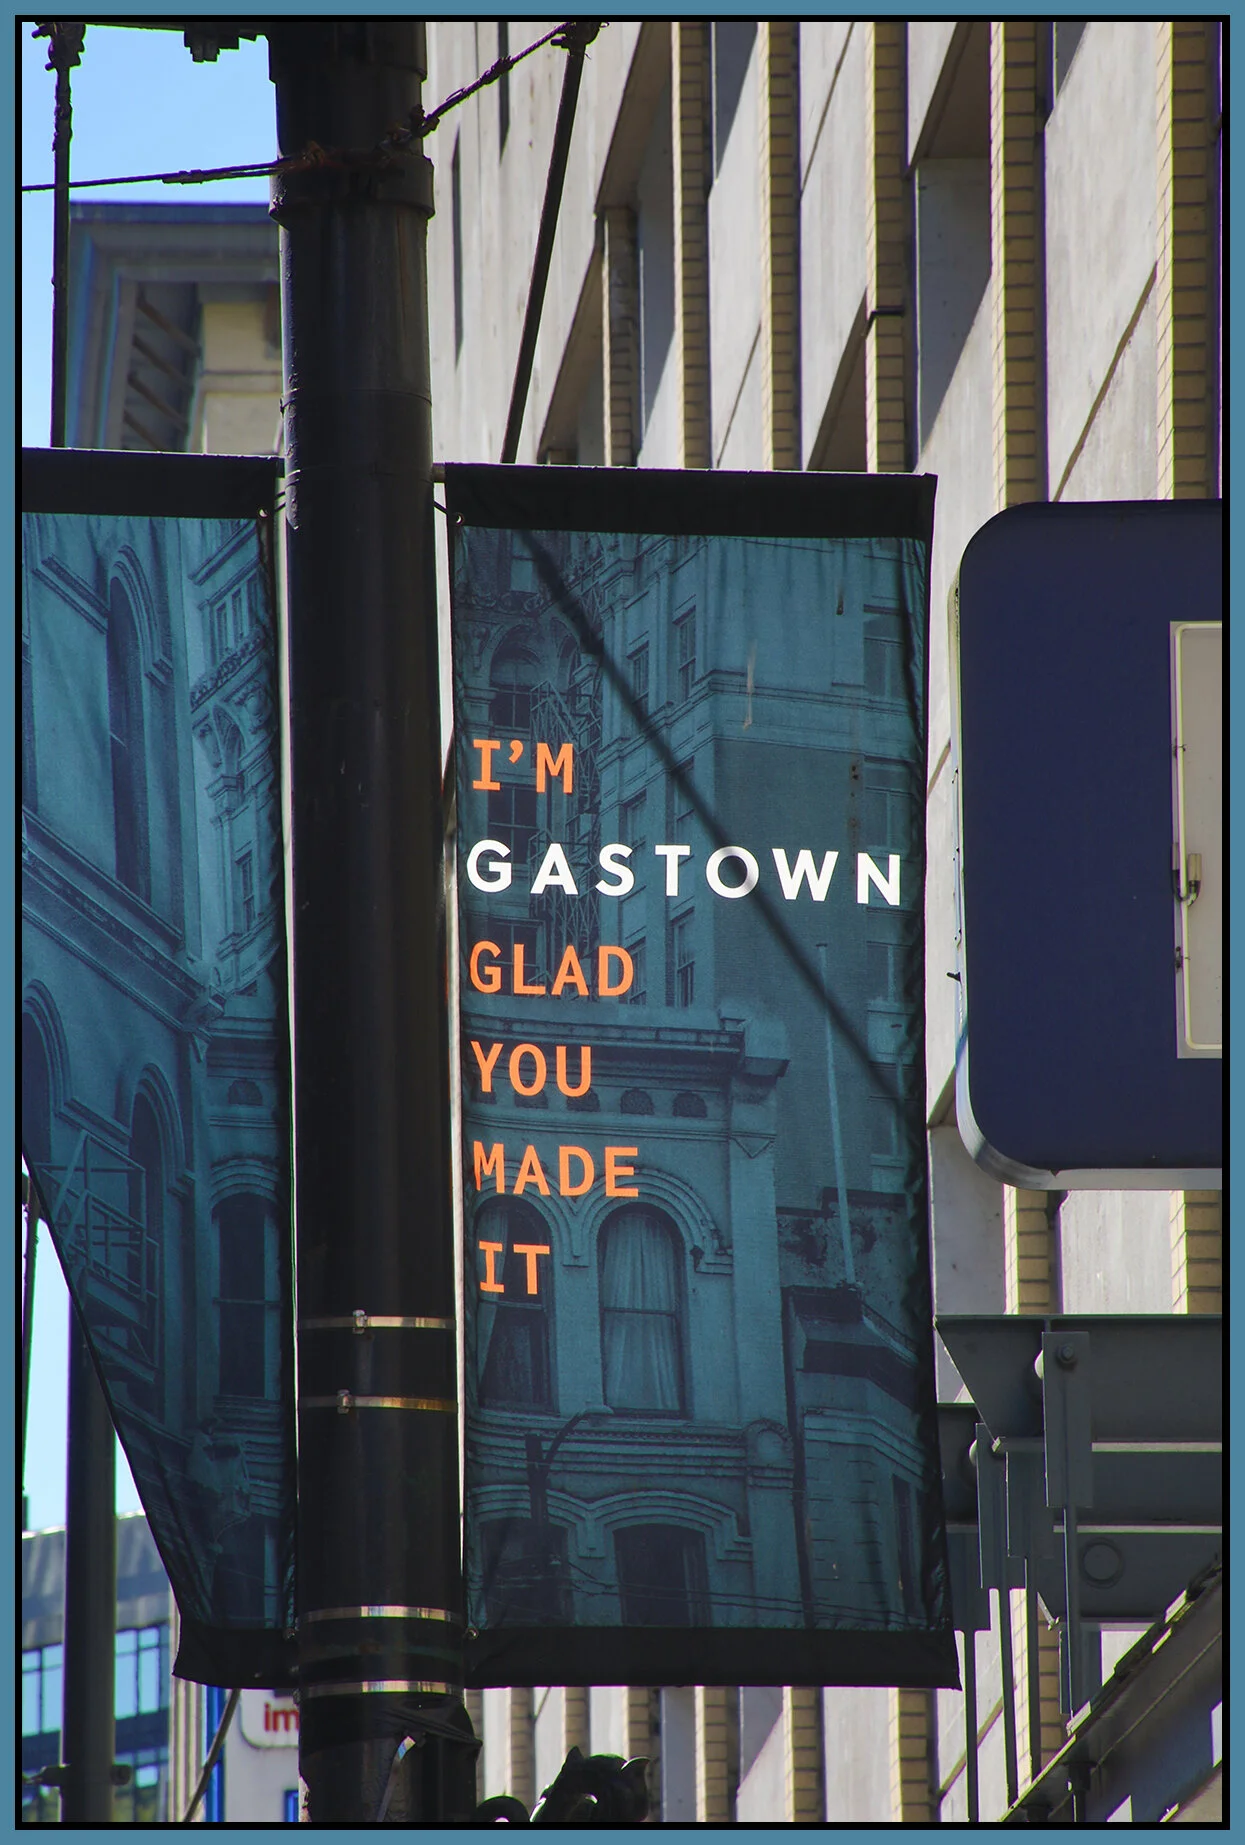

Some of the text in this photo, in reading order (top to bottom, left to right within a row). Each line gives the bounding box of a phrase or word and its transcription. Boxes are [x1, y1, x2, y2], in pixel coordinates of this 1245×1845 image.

[473, 739, 574, 794] I'M
[466, 839, 901, 906] GASTOWN
[469, 940, 634, 997] GLAD
[470, 1040, 592, 1098] YOU
[473, 1140, 639, 1198] MADE
[478, 1240, 551, 1295] IT
